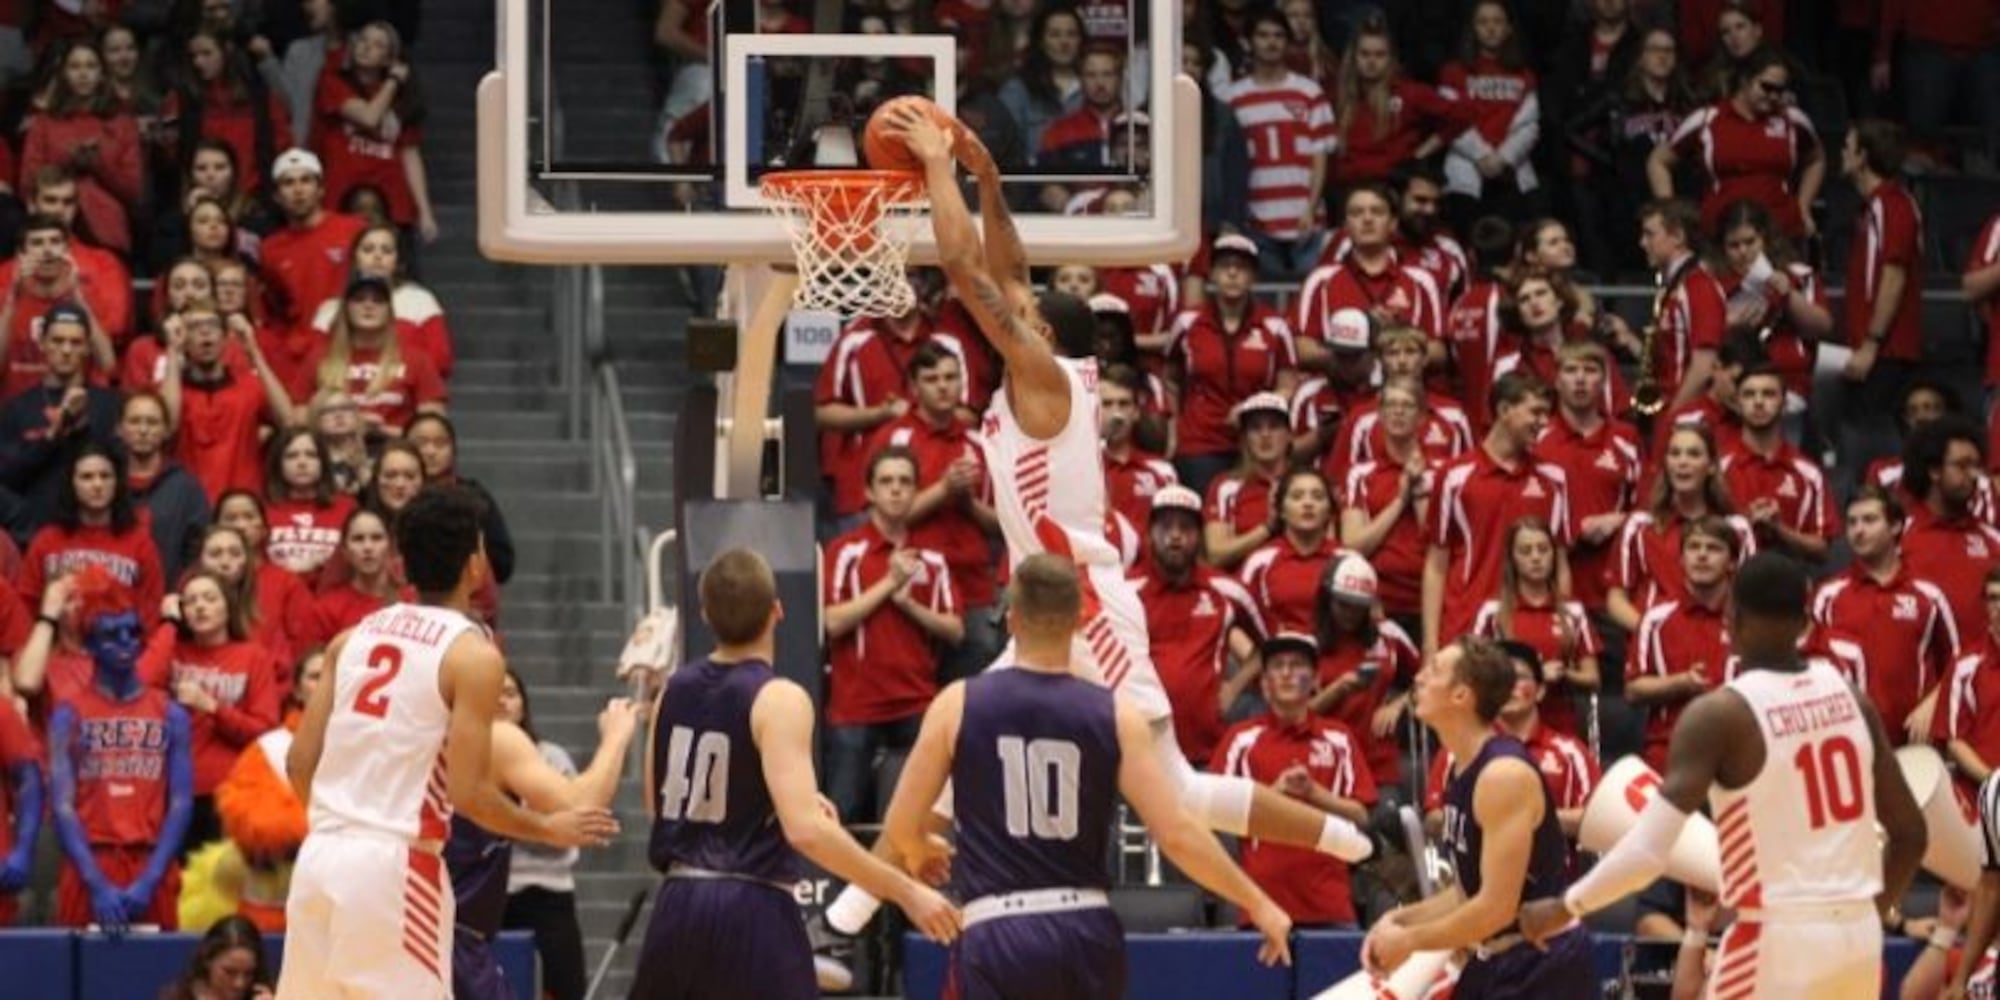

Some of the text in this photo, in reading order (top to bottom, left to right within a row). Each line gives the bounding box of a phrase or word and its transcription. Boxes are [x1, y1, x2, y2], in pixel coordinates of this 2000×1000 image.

[791, 326, 833, 346] 109
[353, 643, 402, 719] 2
[659, 726, 731, 823] 40
[997, 736, 1081, 840] 10
[1794, 735, 1865, 830] 10
[793, 879, 830, 905] er
